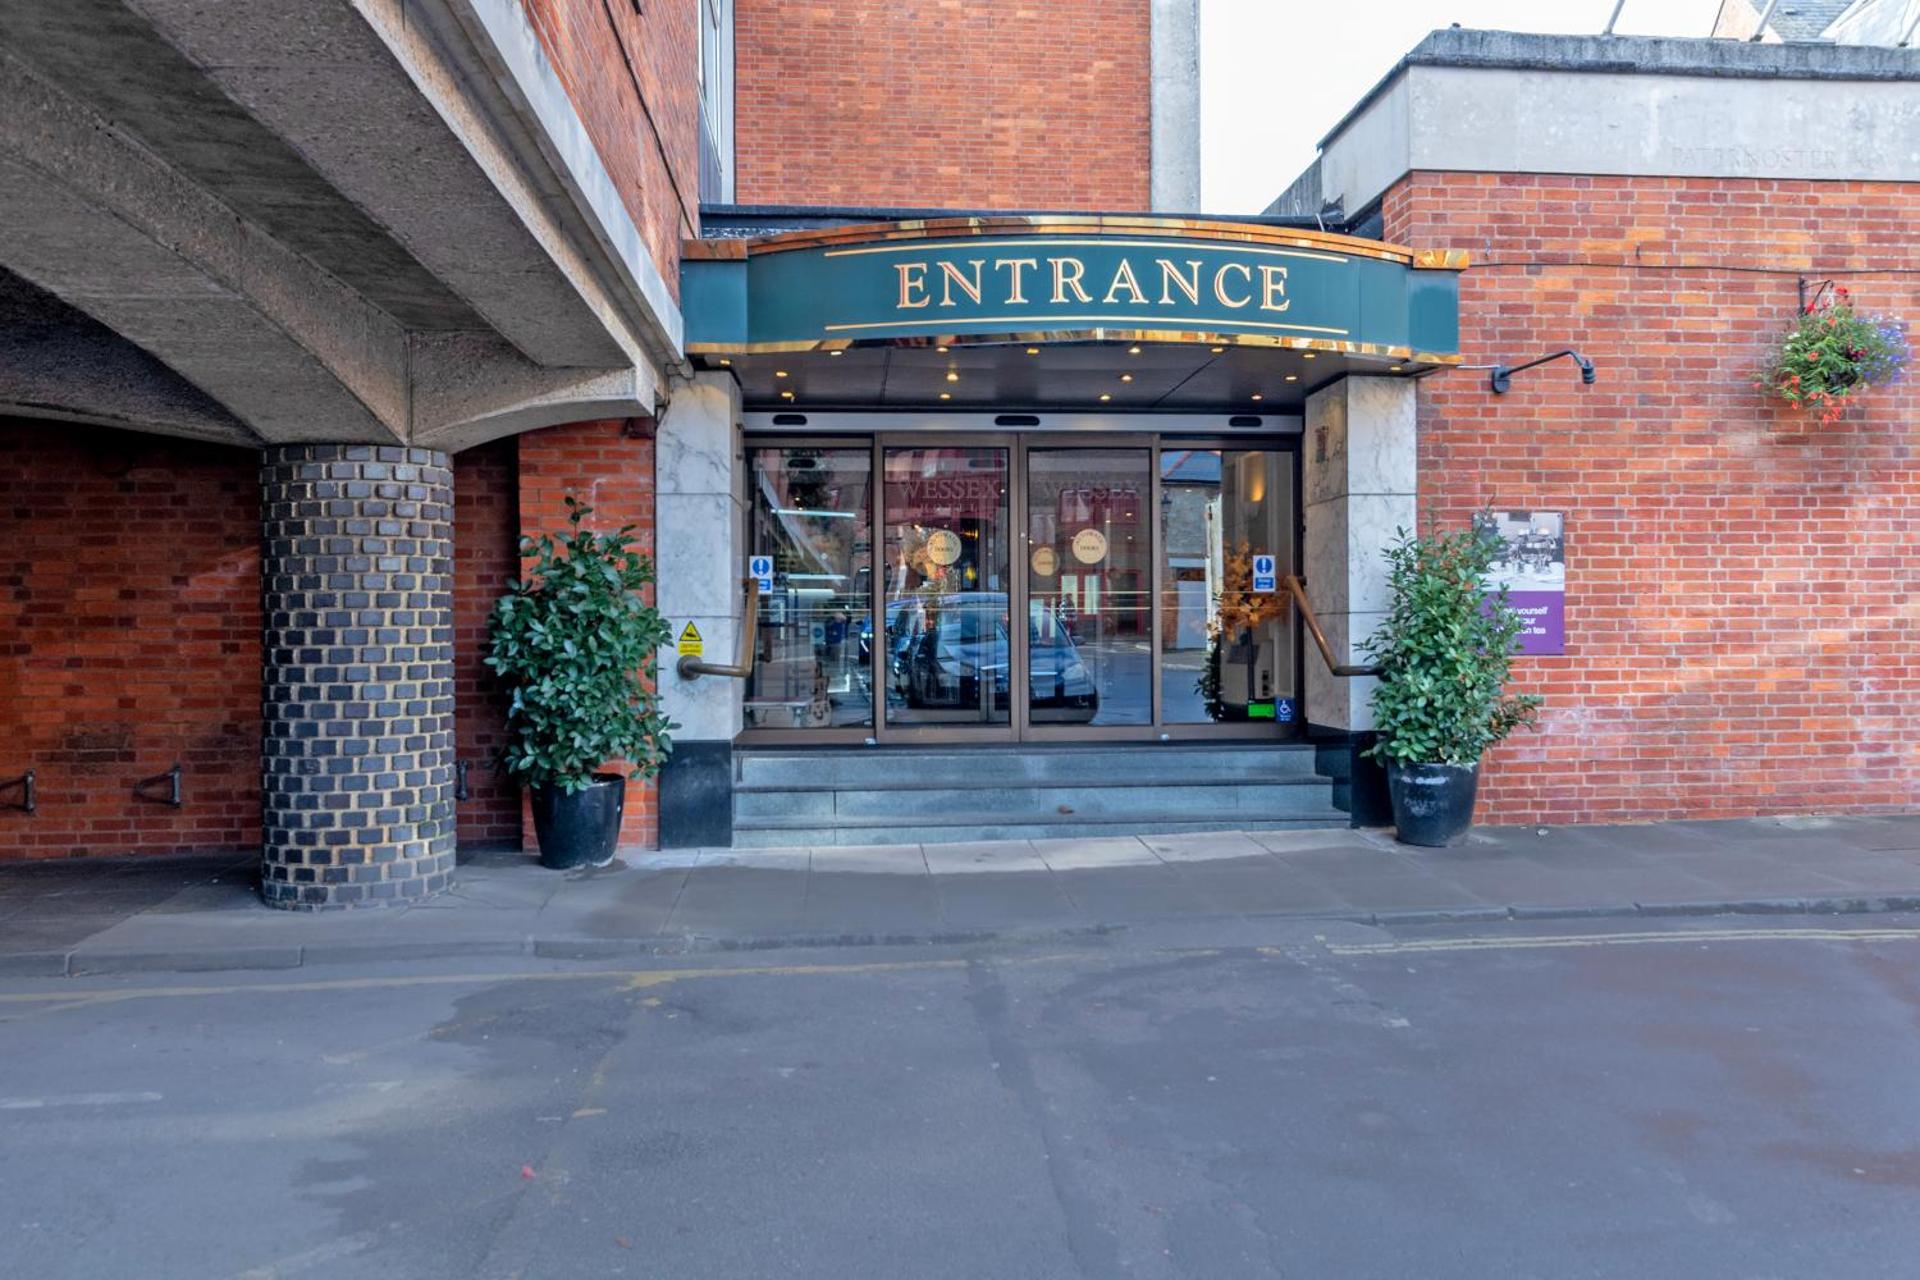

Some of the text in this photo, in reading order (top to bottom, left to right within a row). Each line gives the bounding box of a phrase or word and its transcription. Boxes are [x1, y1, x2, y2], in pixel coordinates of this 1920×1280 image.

[893, 257, 1291, 312] ENTRANCE
[901, 479, 1001, 499] WESSEX
[1517, 606, 1548, 616] yourself
[1532, 626, 1546, 634] tea
